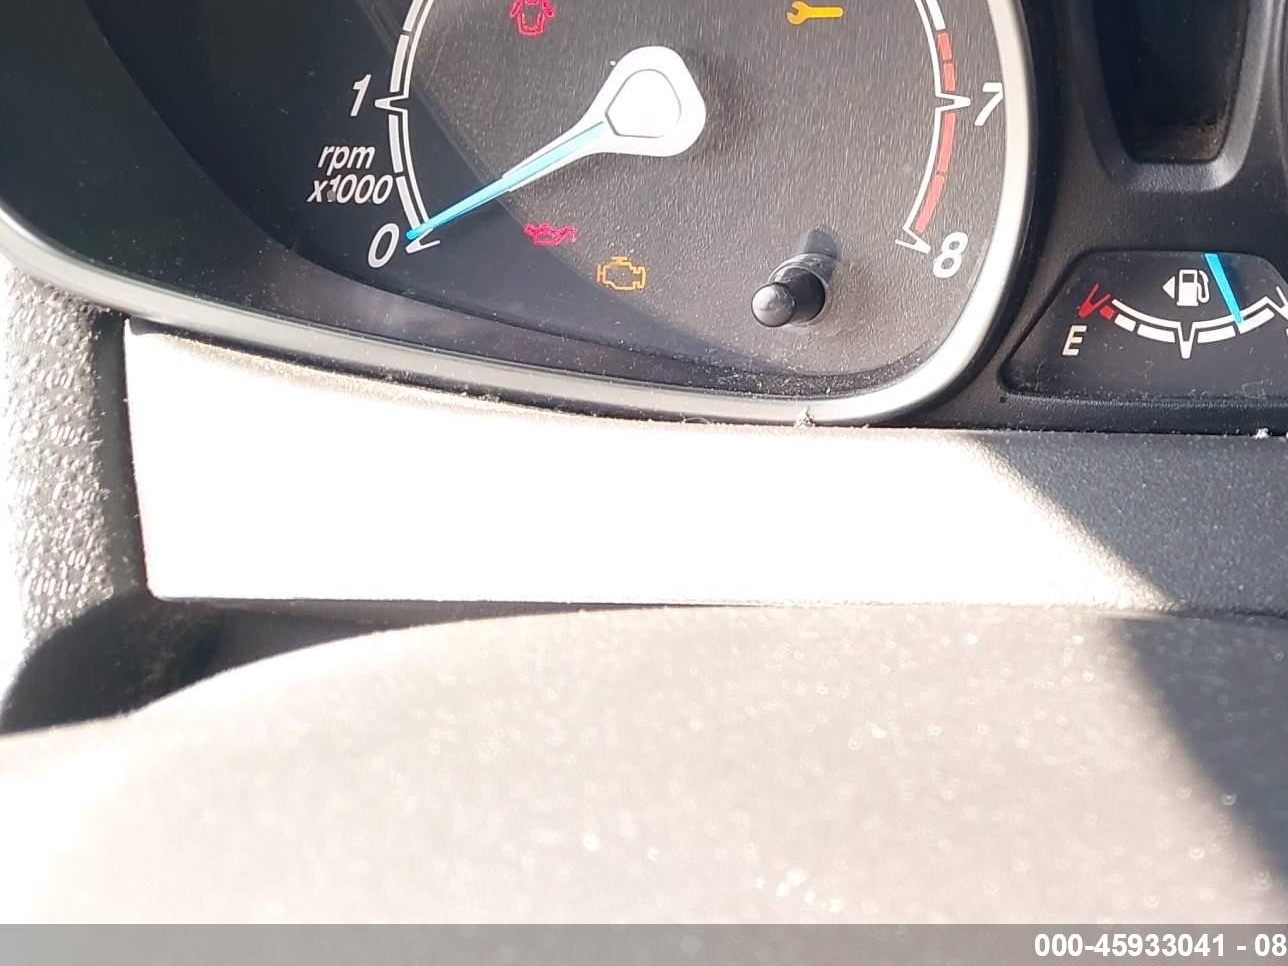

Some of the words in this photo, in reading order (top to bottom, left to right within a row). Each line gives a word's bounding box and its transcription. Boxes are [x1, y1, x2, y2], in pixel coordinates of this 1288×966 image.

[350, 75, 372, 116] 1
[975, 83, 1003, 126] 7
[317, 144, 375, 175] rpm
[307, 175, 393, 203] x1000
[367, 224, 399, 267] 0
[933, 233, 968, 278] 8
[1062, 325, 1087, 356] E
